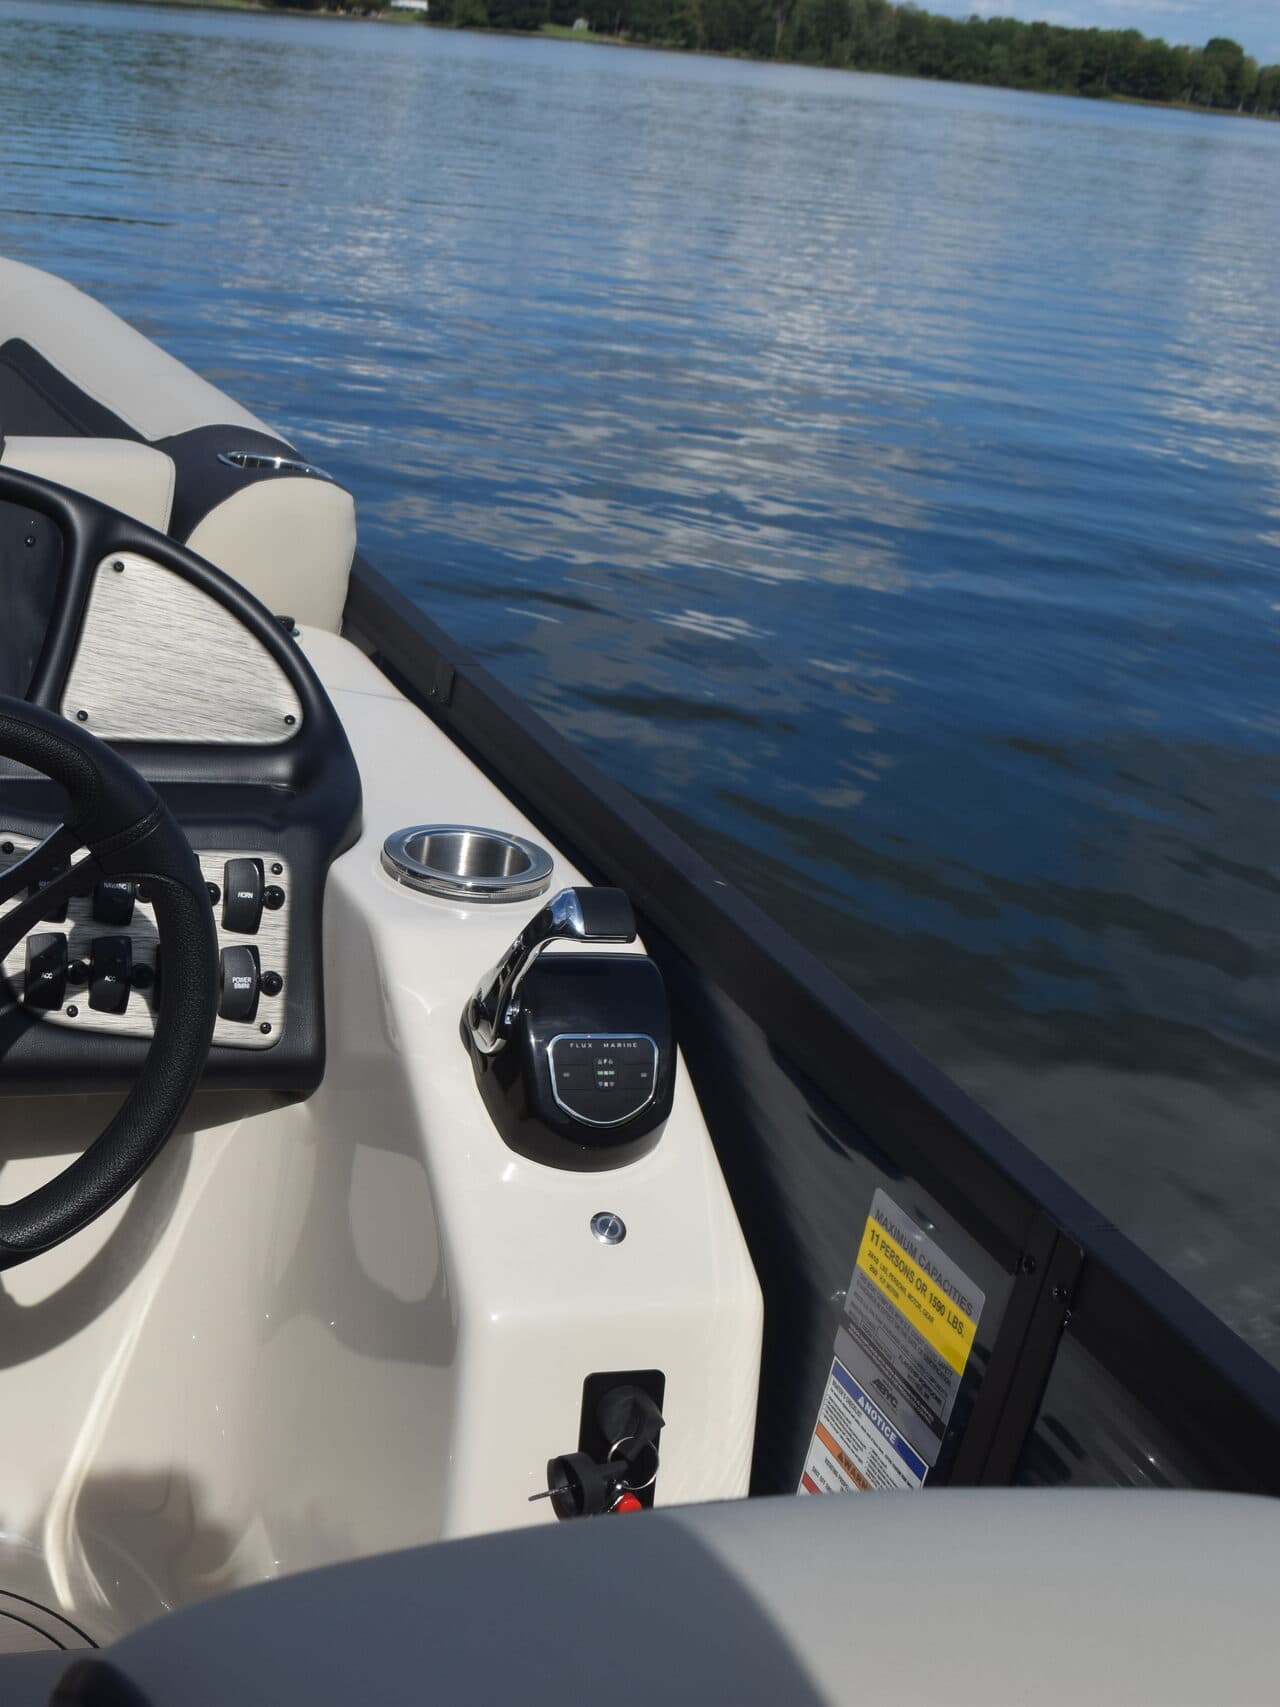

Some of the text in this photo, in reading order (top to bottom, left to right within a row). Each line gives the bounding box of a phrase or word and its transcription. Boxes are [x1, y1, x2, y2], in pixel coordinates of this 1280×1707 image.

[237, 891, 254, 899] HORN
[41, 972, 53, 980] ACC
[232, 976, 252, 984] POWER
[875, 1209, 916, 1257] MAXIMUM
[919, 1254, 973, 1316] CAPACITIES
[870, 1229, 965, 1337] 11 PERSONS OR 1590 LBS.
[865, 1404, 897, 1444] NOTICE
